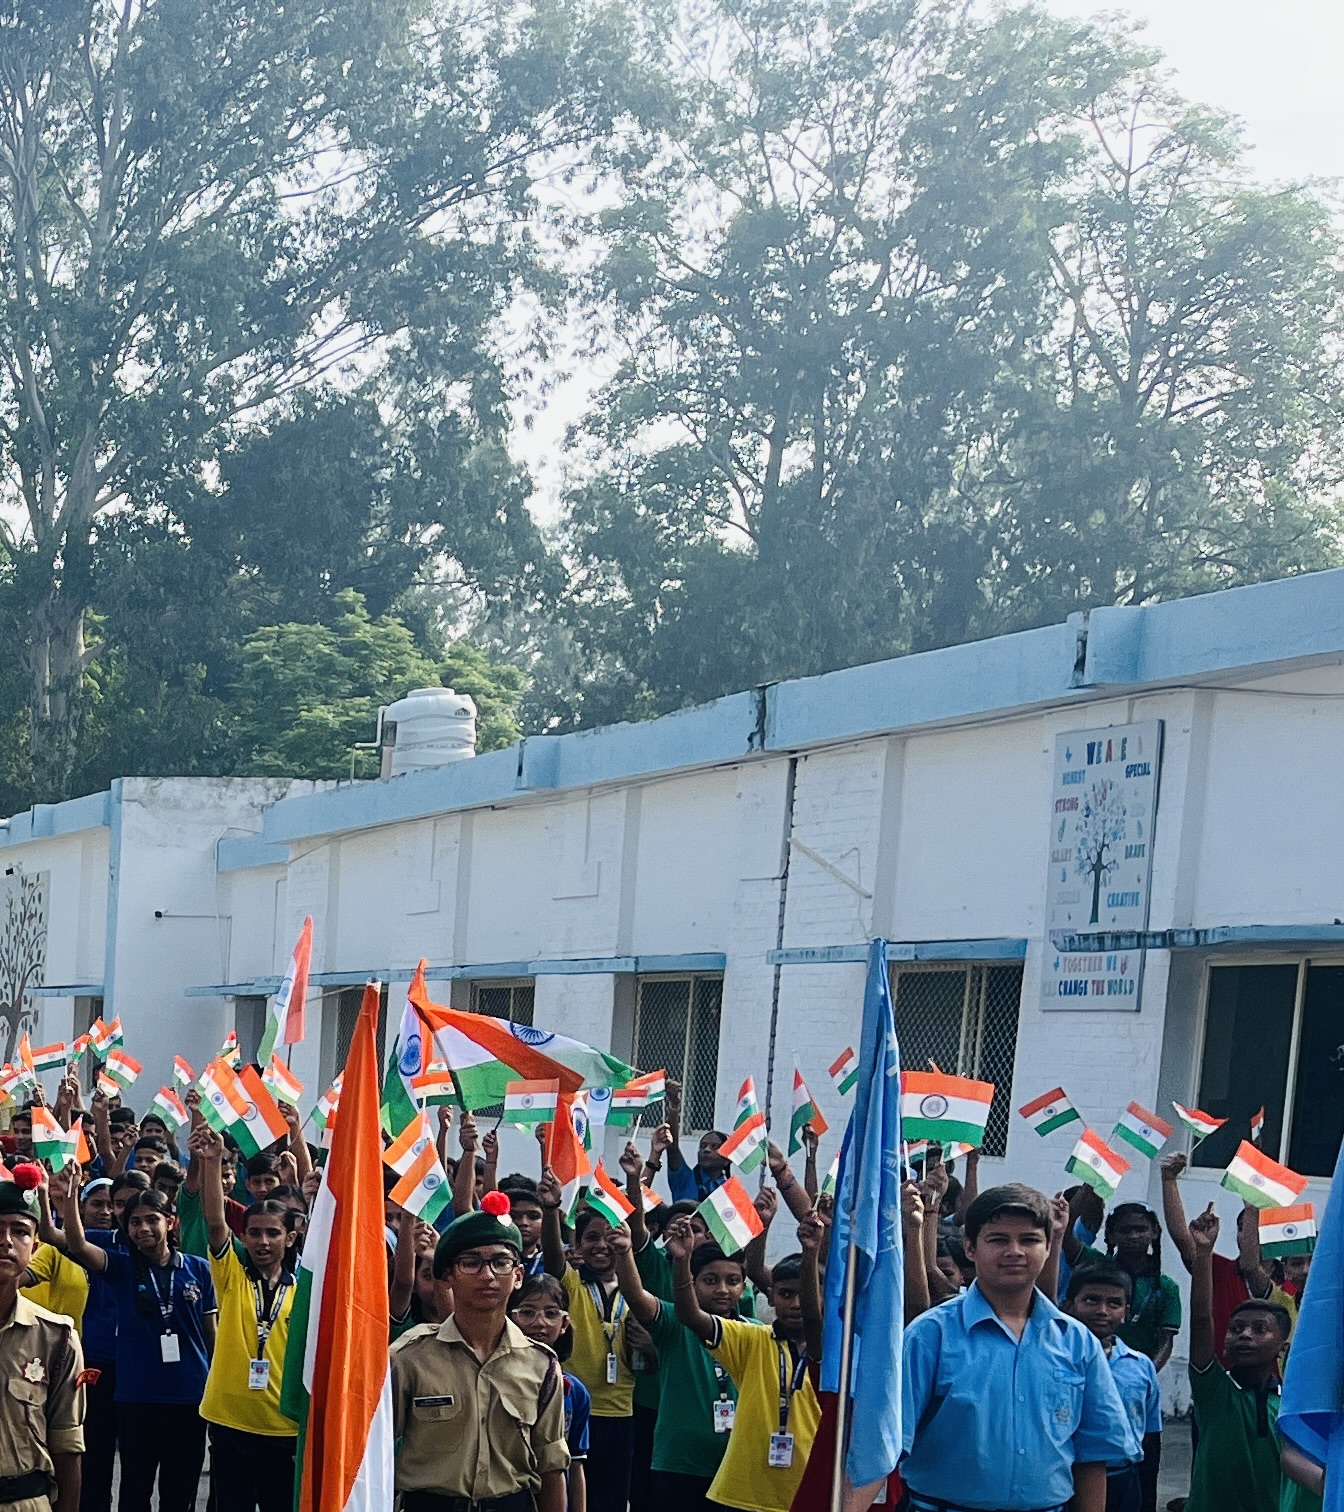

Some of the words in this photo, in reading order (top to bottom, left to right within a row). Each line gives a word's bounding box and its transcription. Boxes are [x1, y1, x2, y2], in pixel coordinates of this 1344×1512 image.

[1087, 741, 1102, 765] WE
[1125, 762, 1150, 778] SPECIAL
[1107, 892, 1140, 908] CREATIVE
[1063, 956, 1103, 973] TOGETHER
[1058, 980, 1088, 997] CHANGE
[1091, 979, 1105, 996] THE
[1108, 978, 1134, 996] WORLD
